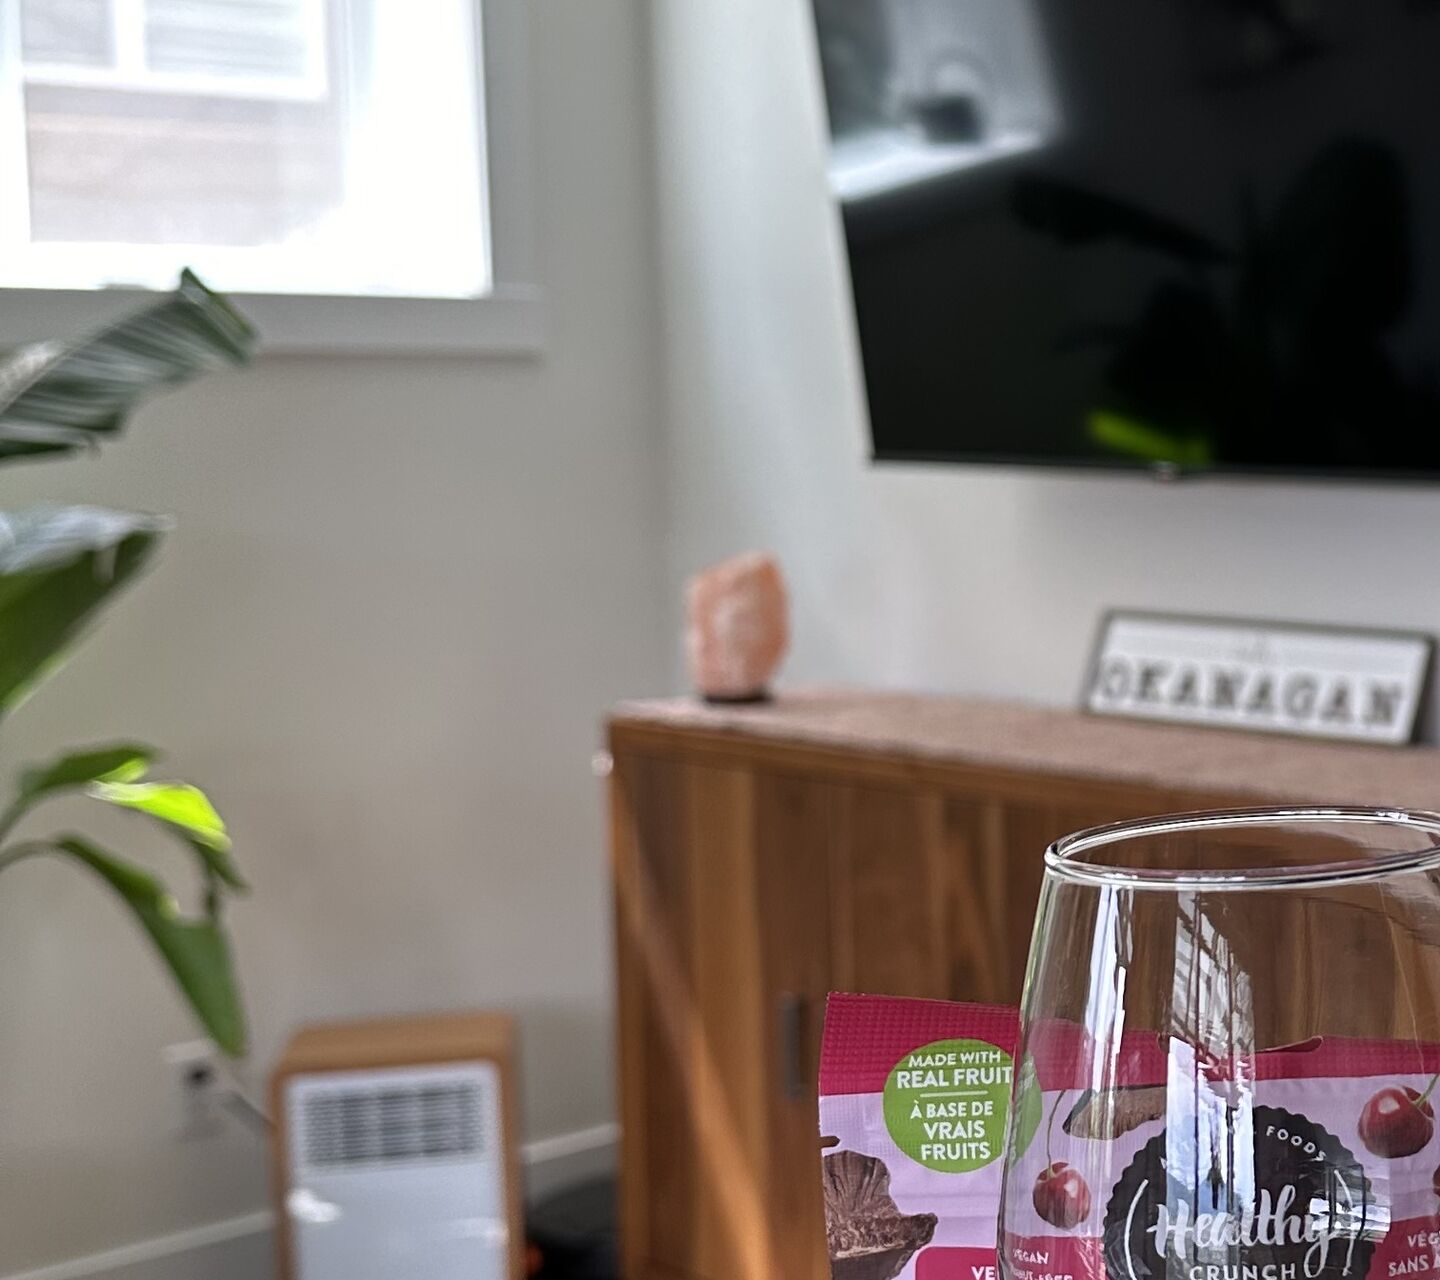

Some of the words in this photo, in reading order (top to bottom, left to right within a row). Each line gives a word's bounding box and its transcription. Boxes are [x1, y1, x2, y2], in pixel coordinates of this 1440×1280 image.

[1101, 657, 1404, 726] OKANAGAN
[908, 1053, 957, 1068] MADE
[960, 1051, 1001, 1064] WITH
[896, 1069, 949, 1089] REAL
[953, 1066, 1013, 1086] FRUIT
[910, 1100, 922, 1120] À
[926, 1101, 967, 1119] BASE
[971, 1101, 993, 1116] DE
[924, 1120, 986, 1140] VRAIS
[921, 1142, 992, 1161] FRUITS
[1266, 1125, 1327, 1162] FOODS
[1146, 1184, 1339, 1279] Healthy
[1388, 1254, 1430, 1277] SANS
